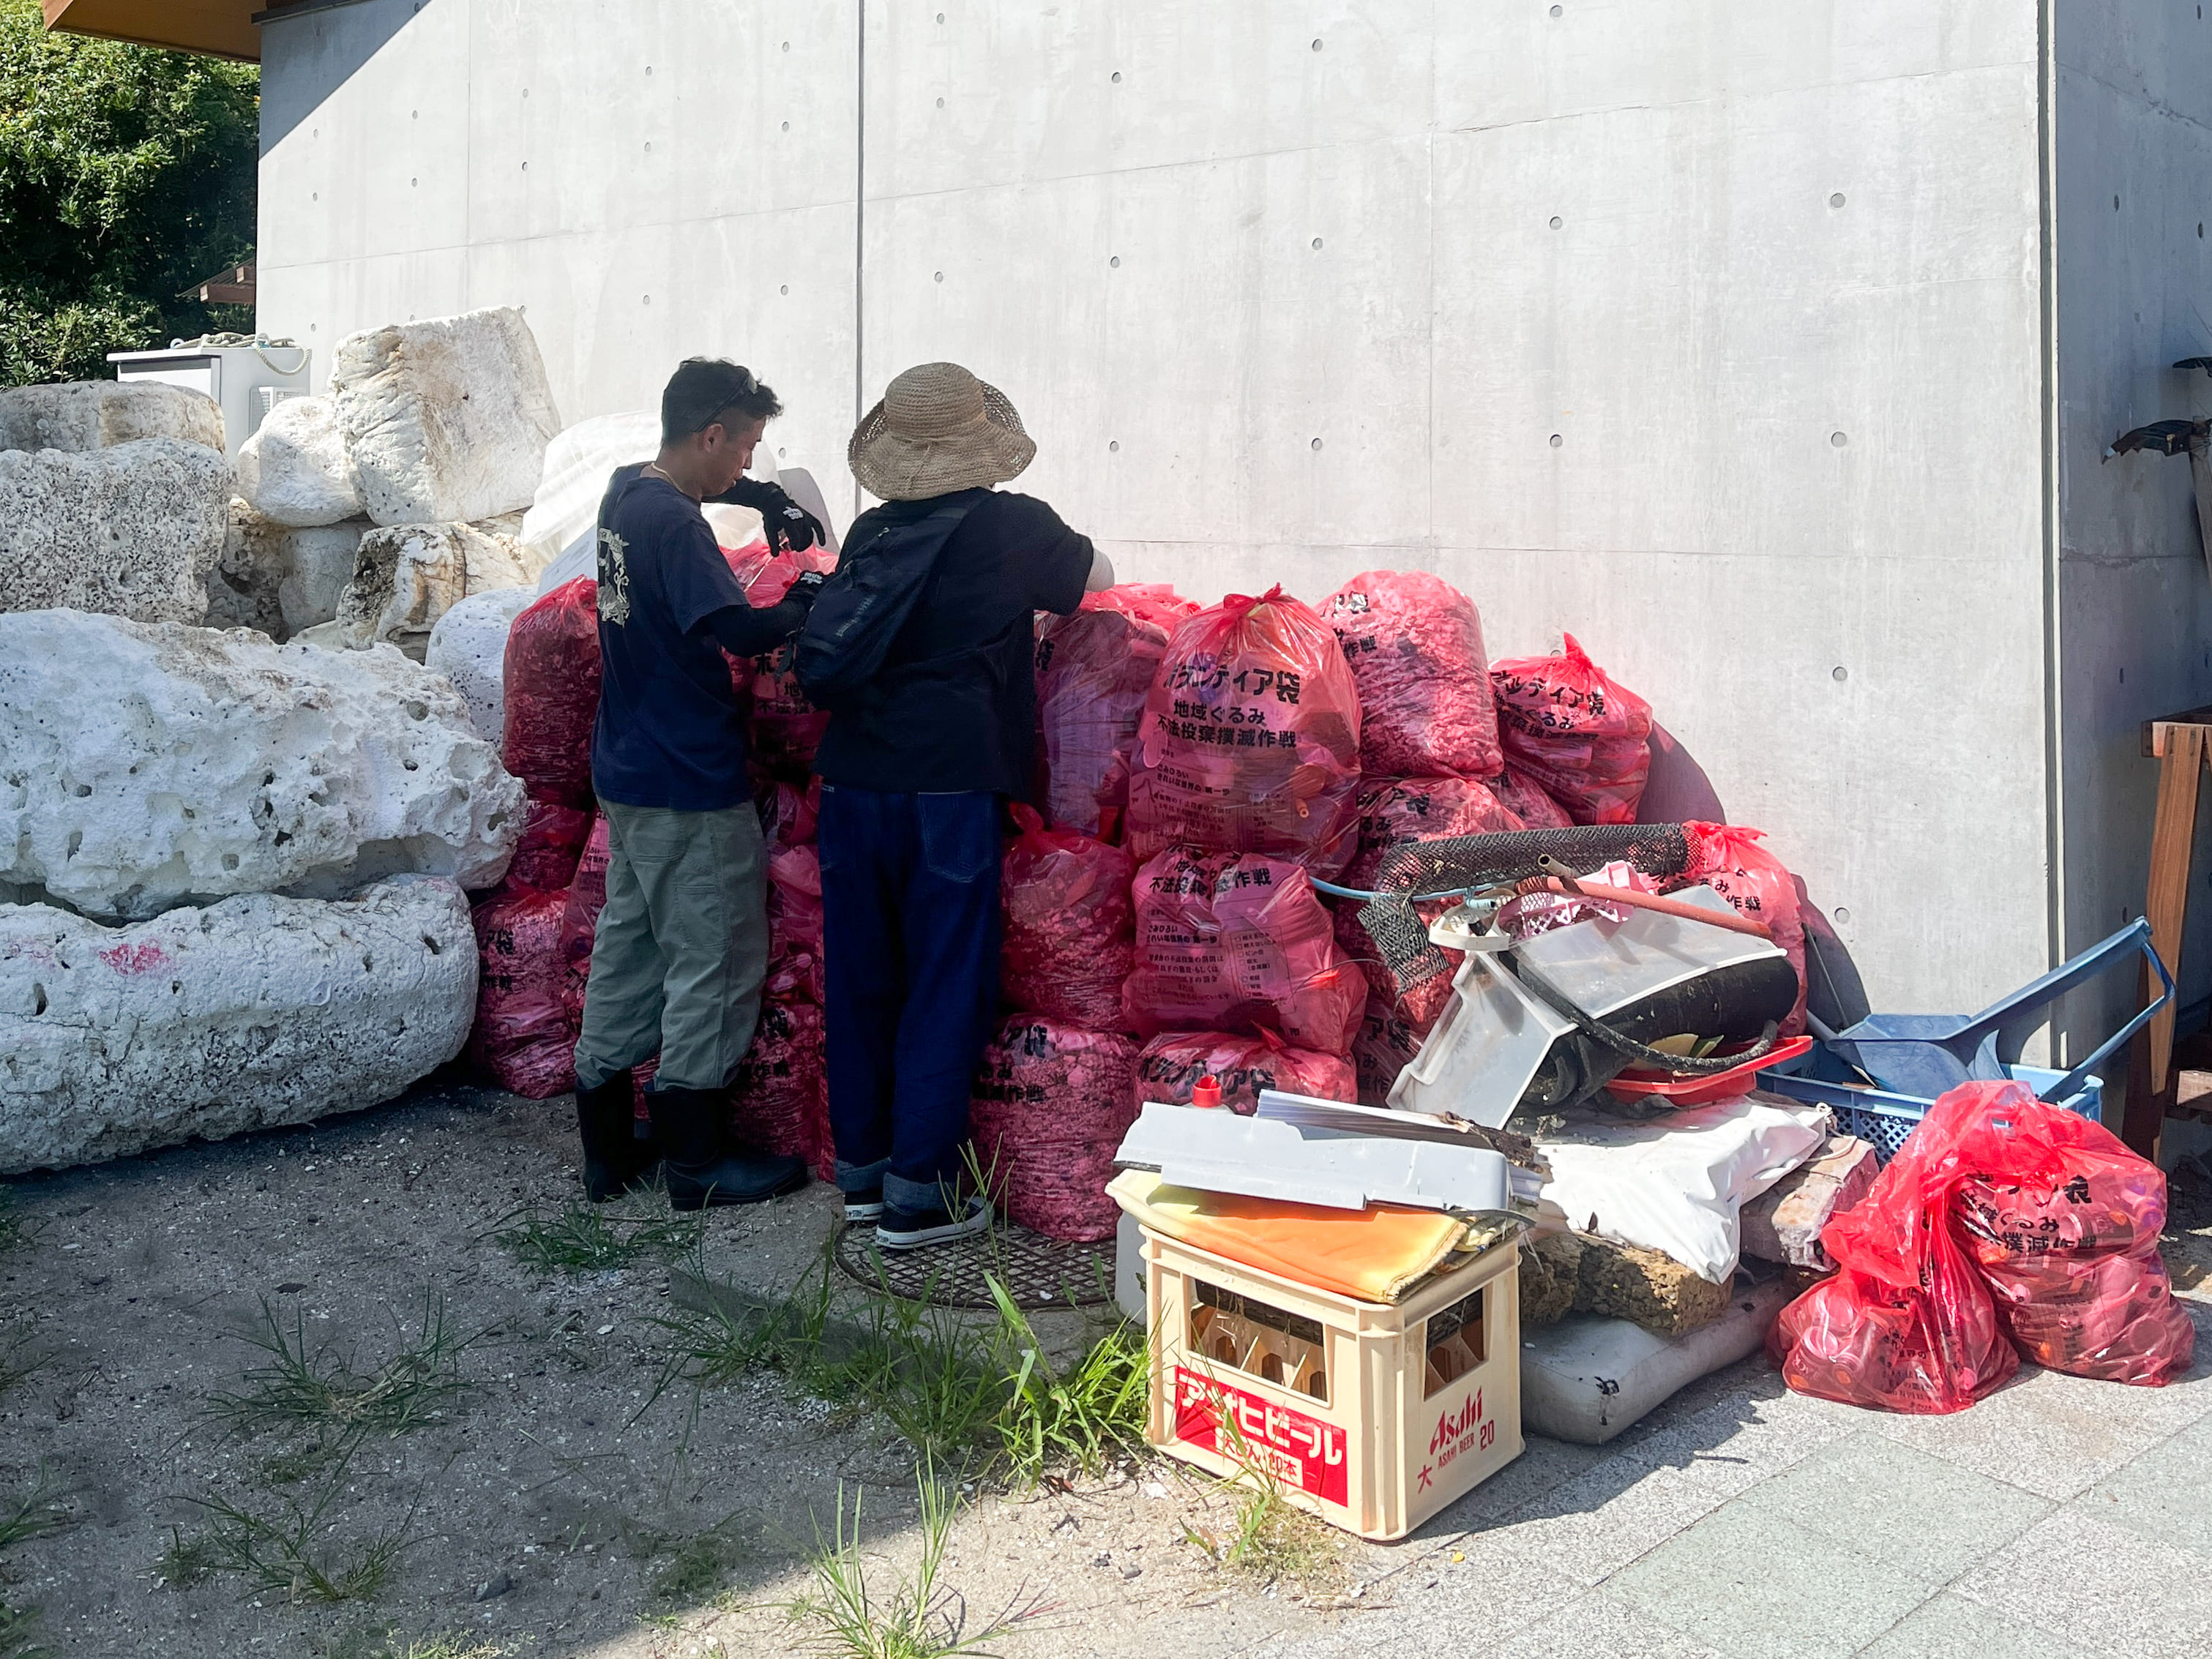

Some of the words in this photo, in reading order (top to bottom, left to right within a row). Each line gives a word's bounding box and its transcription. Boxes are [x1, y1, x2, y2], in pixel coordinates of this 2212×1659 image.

[1173, 699, 1267, 725] 地域ぐるみ
[1430, 1385, 1482, 1456] Asahi
[1480, 1419, 1495, 1452] 20
[1438, 1445, 1457, 1469] ASAHI
[1460, 1433, 1475, 1454] BEER
[1417, 1464, 1432, 1494] 大
